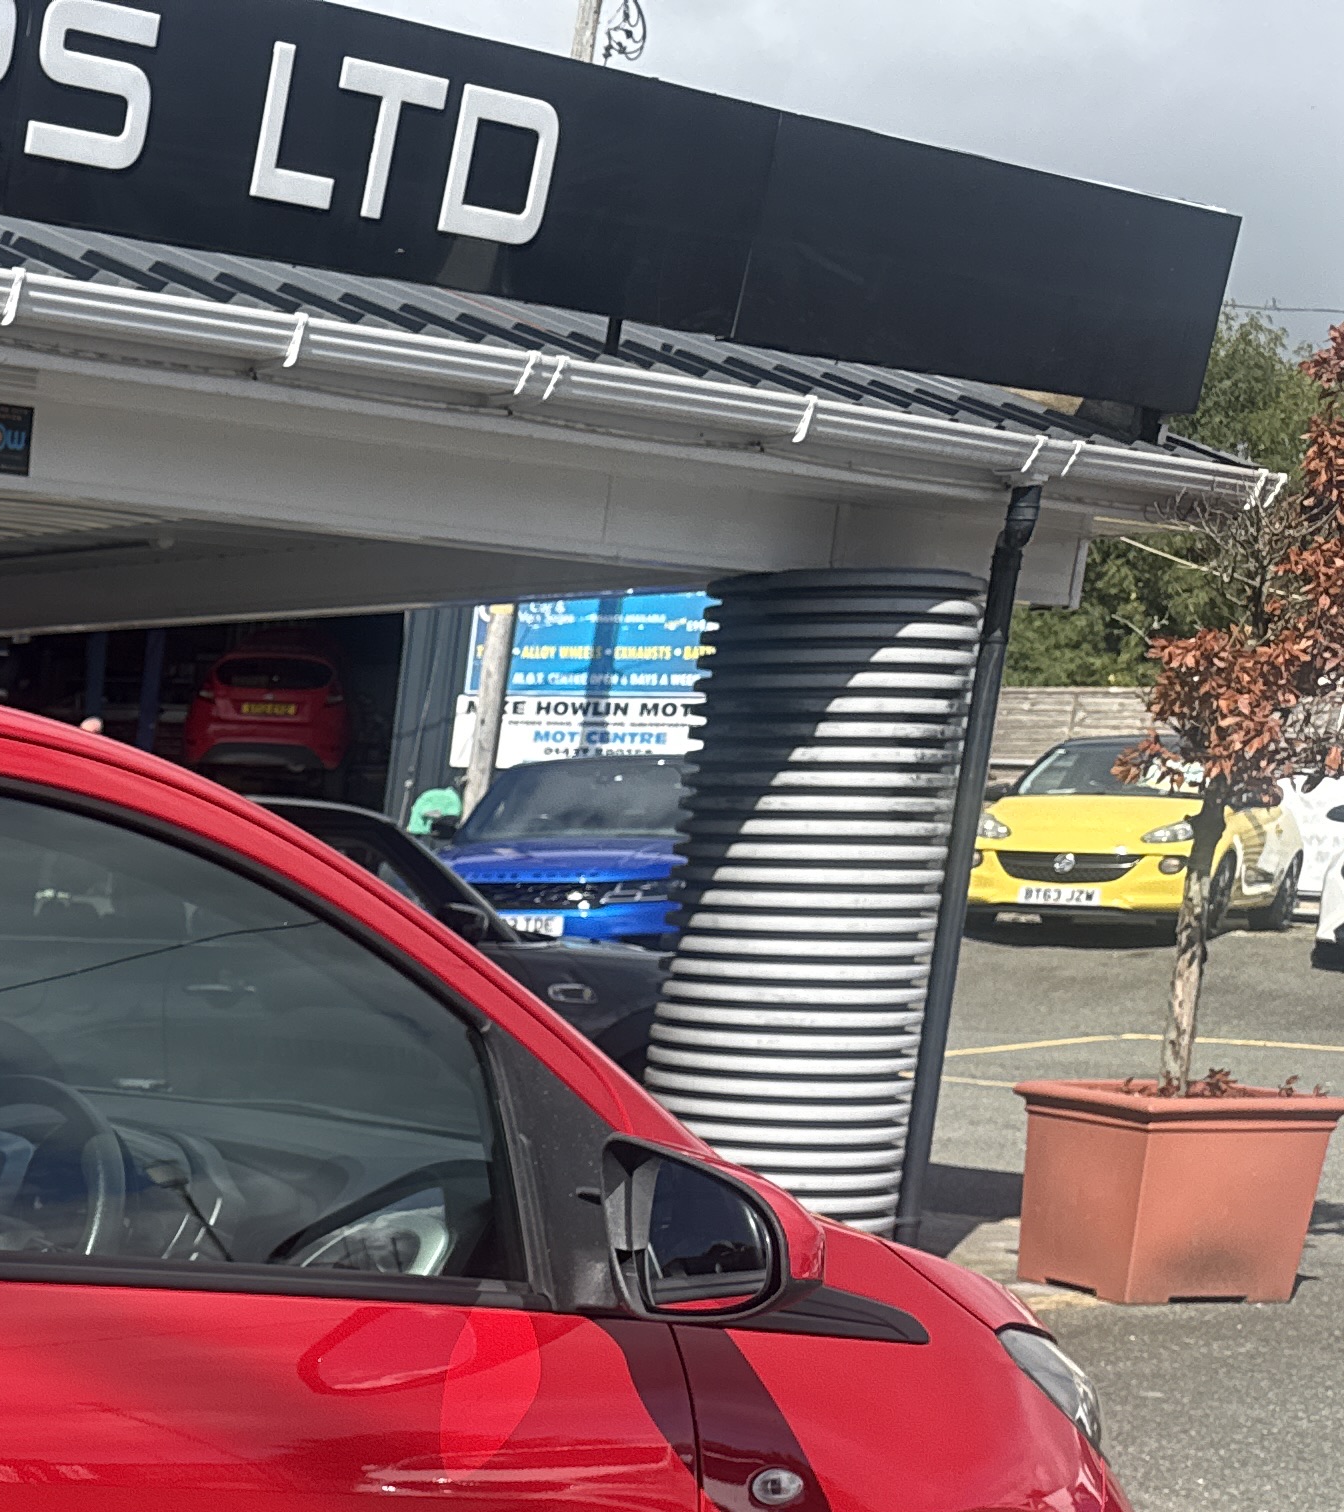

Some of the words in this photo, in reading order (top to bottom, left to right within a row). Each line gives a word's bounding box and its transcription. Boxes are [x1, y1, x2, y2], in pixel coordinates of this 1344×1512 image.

[250, 41, 560, 246] LTD
[536, 701, 630, 717] HOWLIN
[534, 730, 579, 743] MOT
[586, 731, 667, 745] CENTRE
